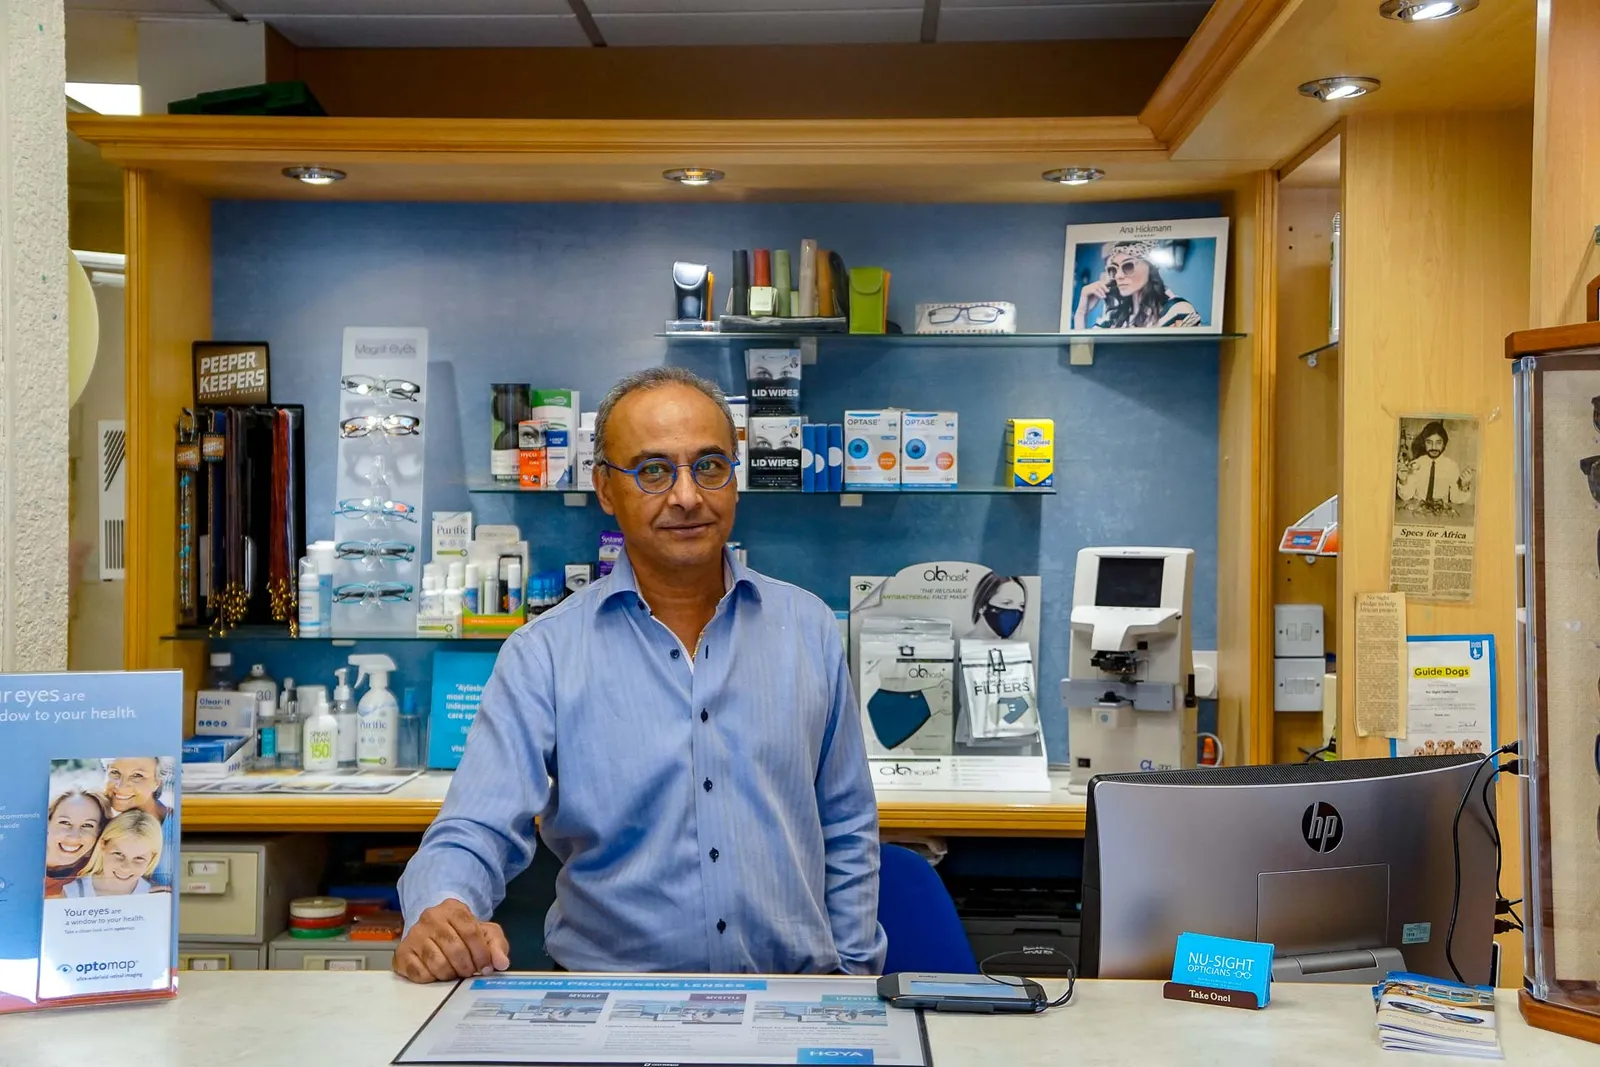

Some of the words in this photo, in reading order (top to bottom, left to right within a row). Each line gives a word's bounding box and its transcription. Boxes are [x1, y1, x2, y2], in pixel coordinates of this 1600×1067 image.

[1119, 226, 1134, 234] Ana
[1136, 224, 1172, 232] Hickmann
[200, 352, 256, 374] PEEPER
[200, 368, 264, 393] KEEPERS
[752, 389, 767, 397] LID
[768, 389, 799, 397] WIPES
[751, 459, 767, 467] LID
[768, 459, 799, 467] WIPES
[436, 525, 468, 535] Purific
[1401, 528, 1424, 537] Specs
[1441, 530, 1466, 539] Africa
[1414, 668, 1442, 676] Guide
[1445, 668, 1469, 677] Dogs
[974, 682, 1030, 696] FILTERS
[14, 689, 60, 708] eyes
[62, 692, 85, 702] are
[35, 710, 49, 720] to
[54, 711, 86, 724] your
[1308, 802, 1338, 853] hp
[88, 908, 109, 917] eyes
[76, 960, 136, 974] optomap
[1188, 952, 1254, 971] NU-SIGHT
[1188, 965, 1231, 976] OPTICIANS
[1189, 990, 1209, 1000] Take
